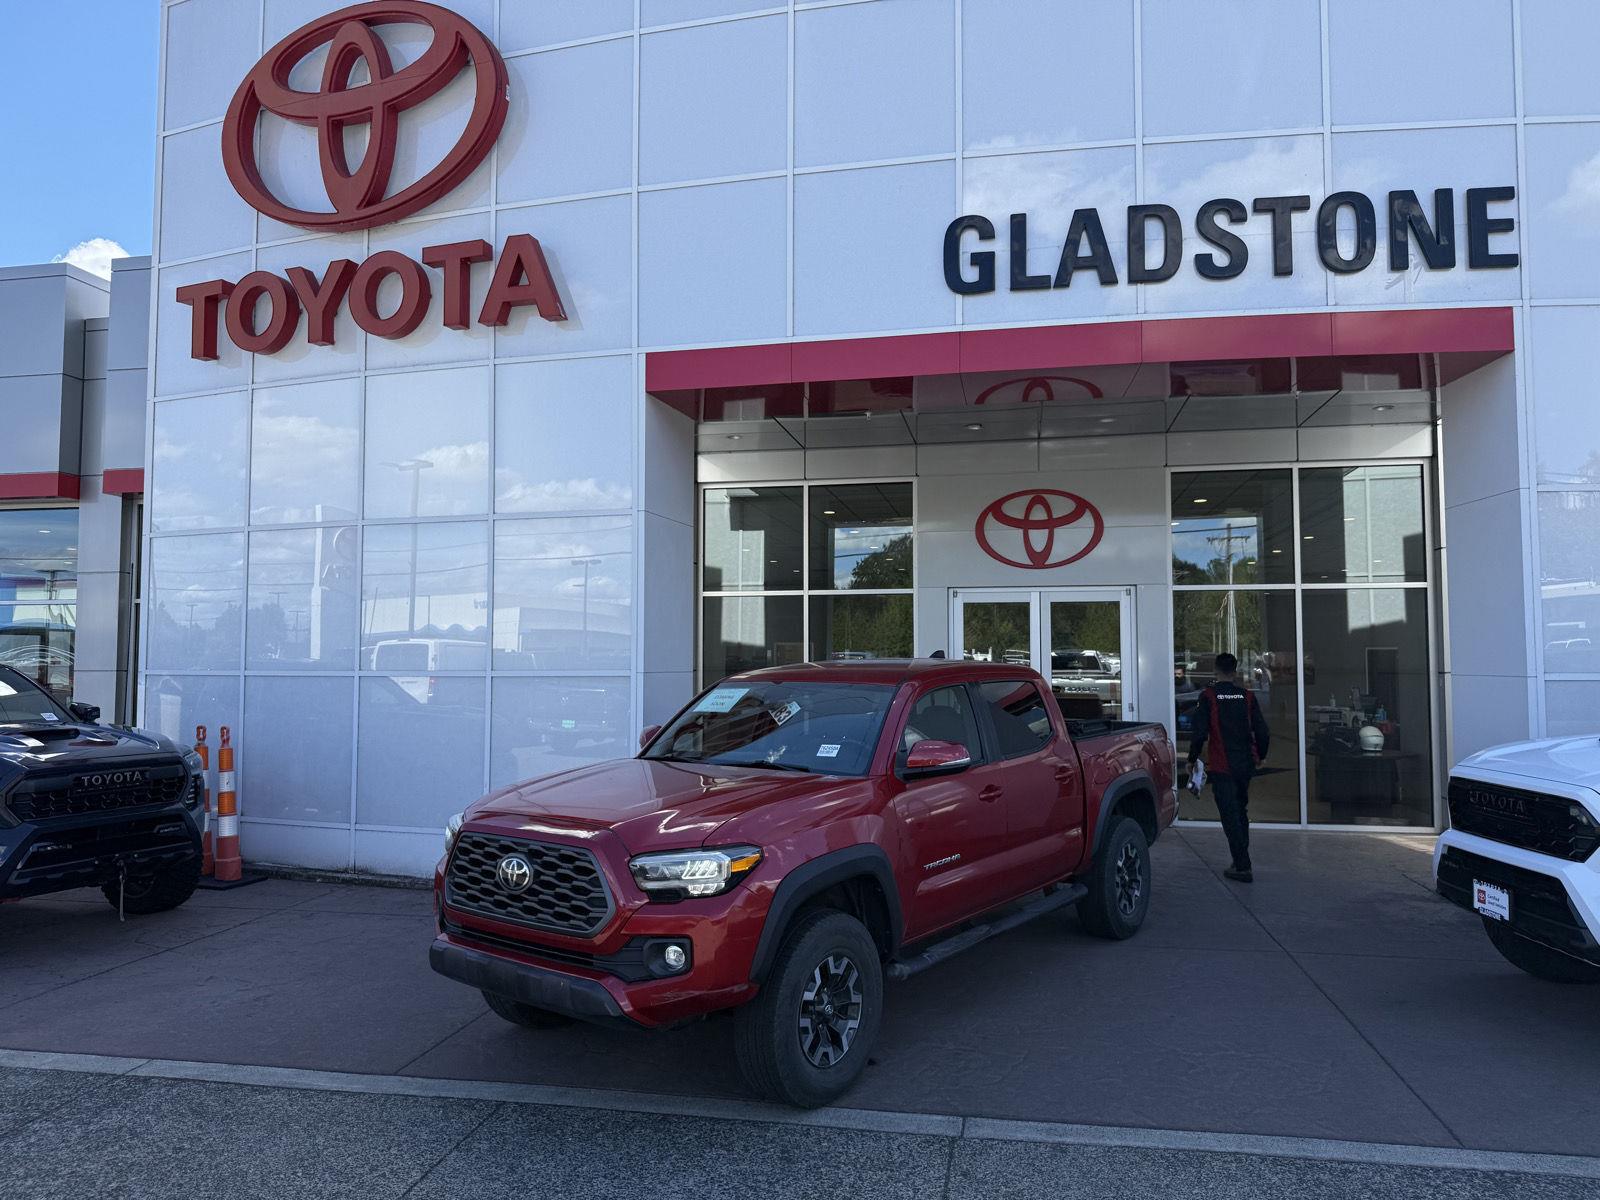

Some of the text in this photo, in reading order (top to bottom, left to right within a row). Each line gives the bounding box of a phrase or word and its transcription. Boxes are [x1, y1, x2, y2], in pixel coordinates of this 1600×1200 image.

[944, 186, 1519, 294] GLADSTONE
[176, 234, 568, 361] TOYOTA
[81, 771, 142, 786] TOYOTA
[1470, 791, 1525, 814] TOYOTA
[923, 853, 961, 870] TACOMA
